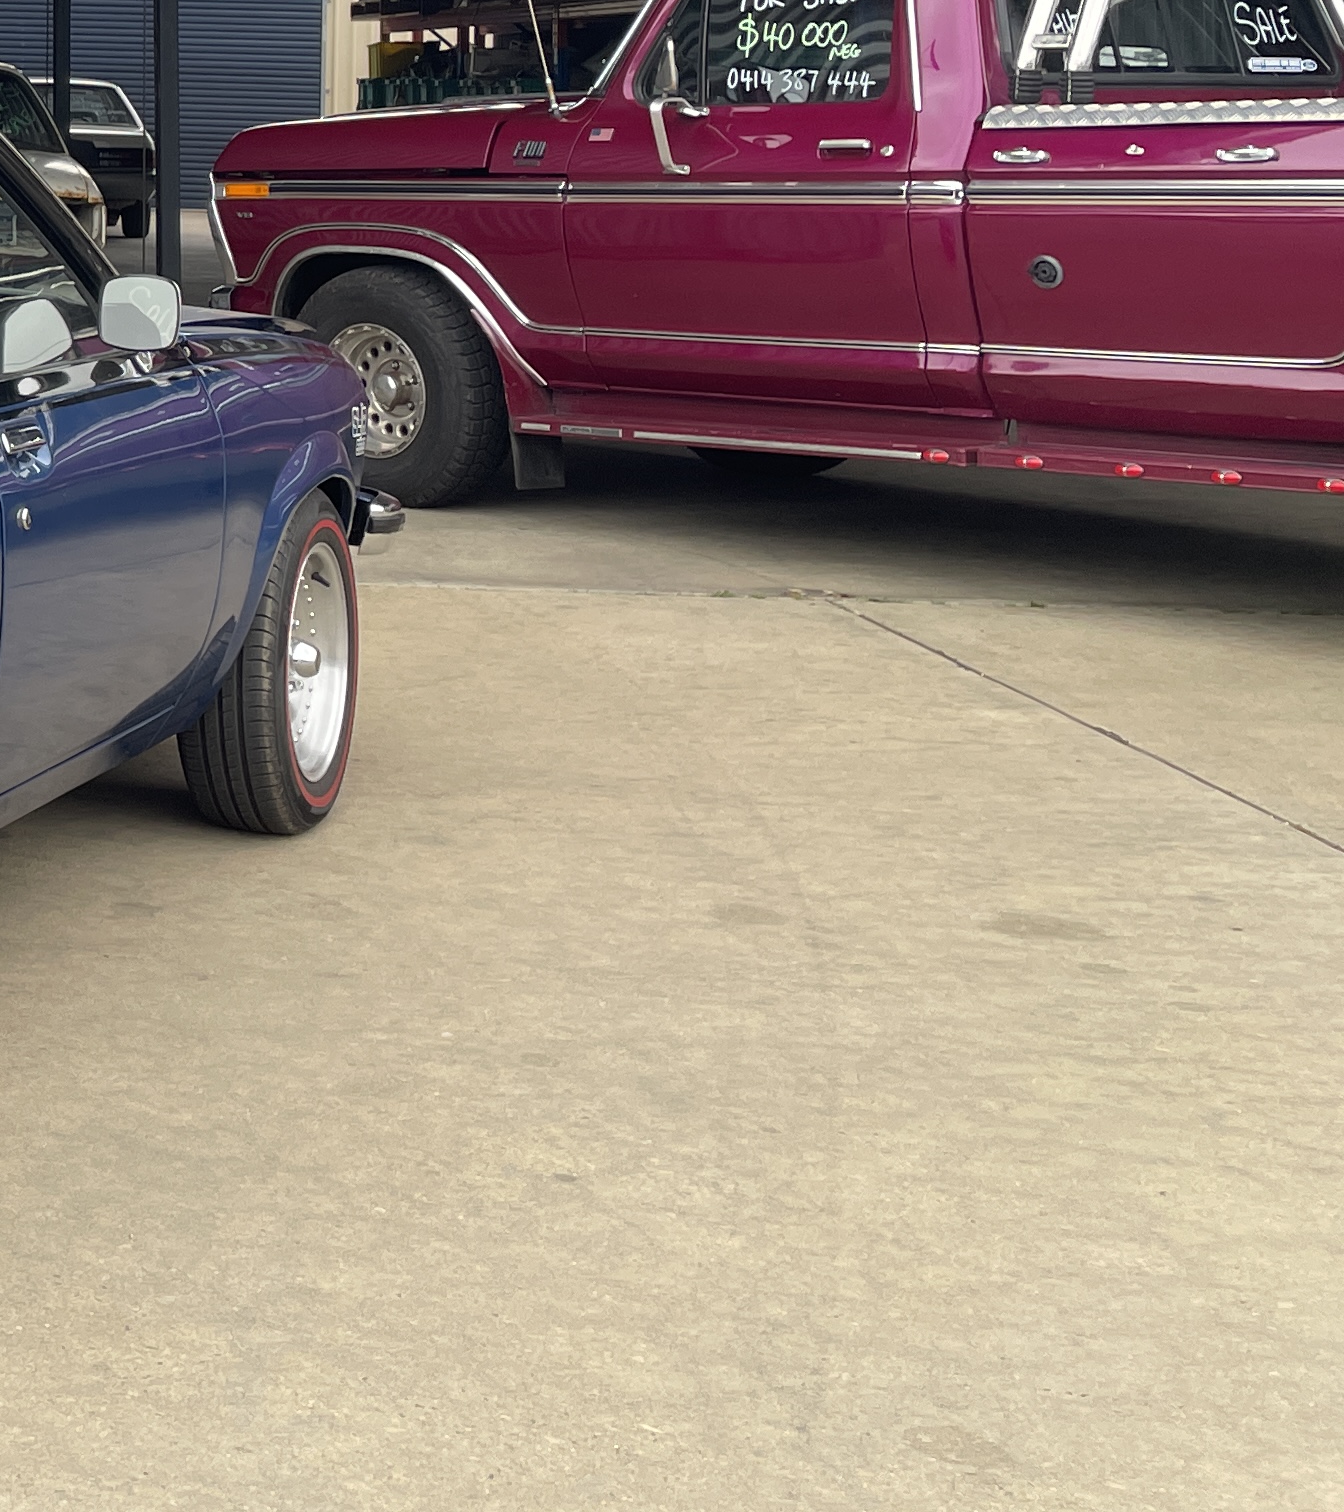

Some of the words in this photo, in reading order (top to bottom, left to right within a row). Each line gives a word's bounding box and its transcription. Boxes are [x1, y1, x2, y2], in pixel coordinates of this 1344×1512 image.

[1233, 1, 1298, 45] SALE
[726, 67, 773, 92] 0414
[779, 68, 820, 93] 387
[827, 69, 877, 98] 444
